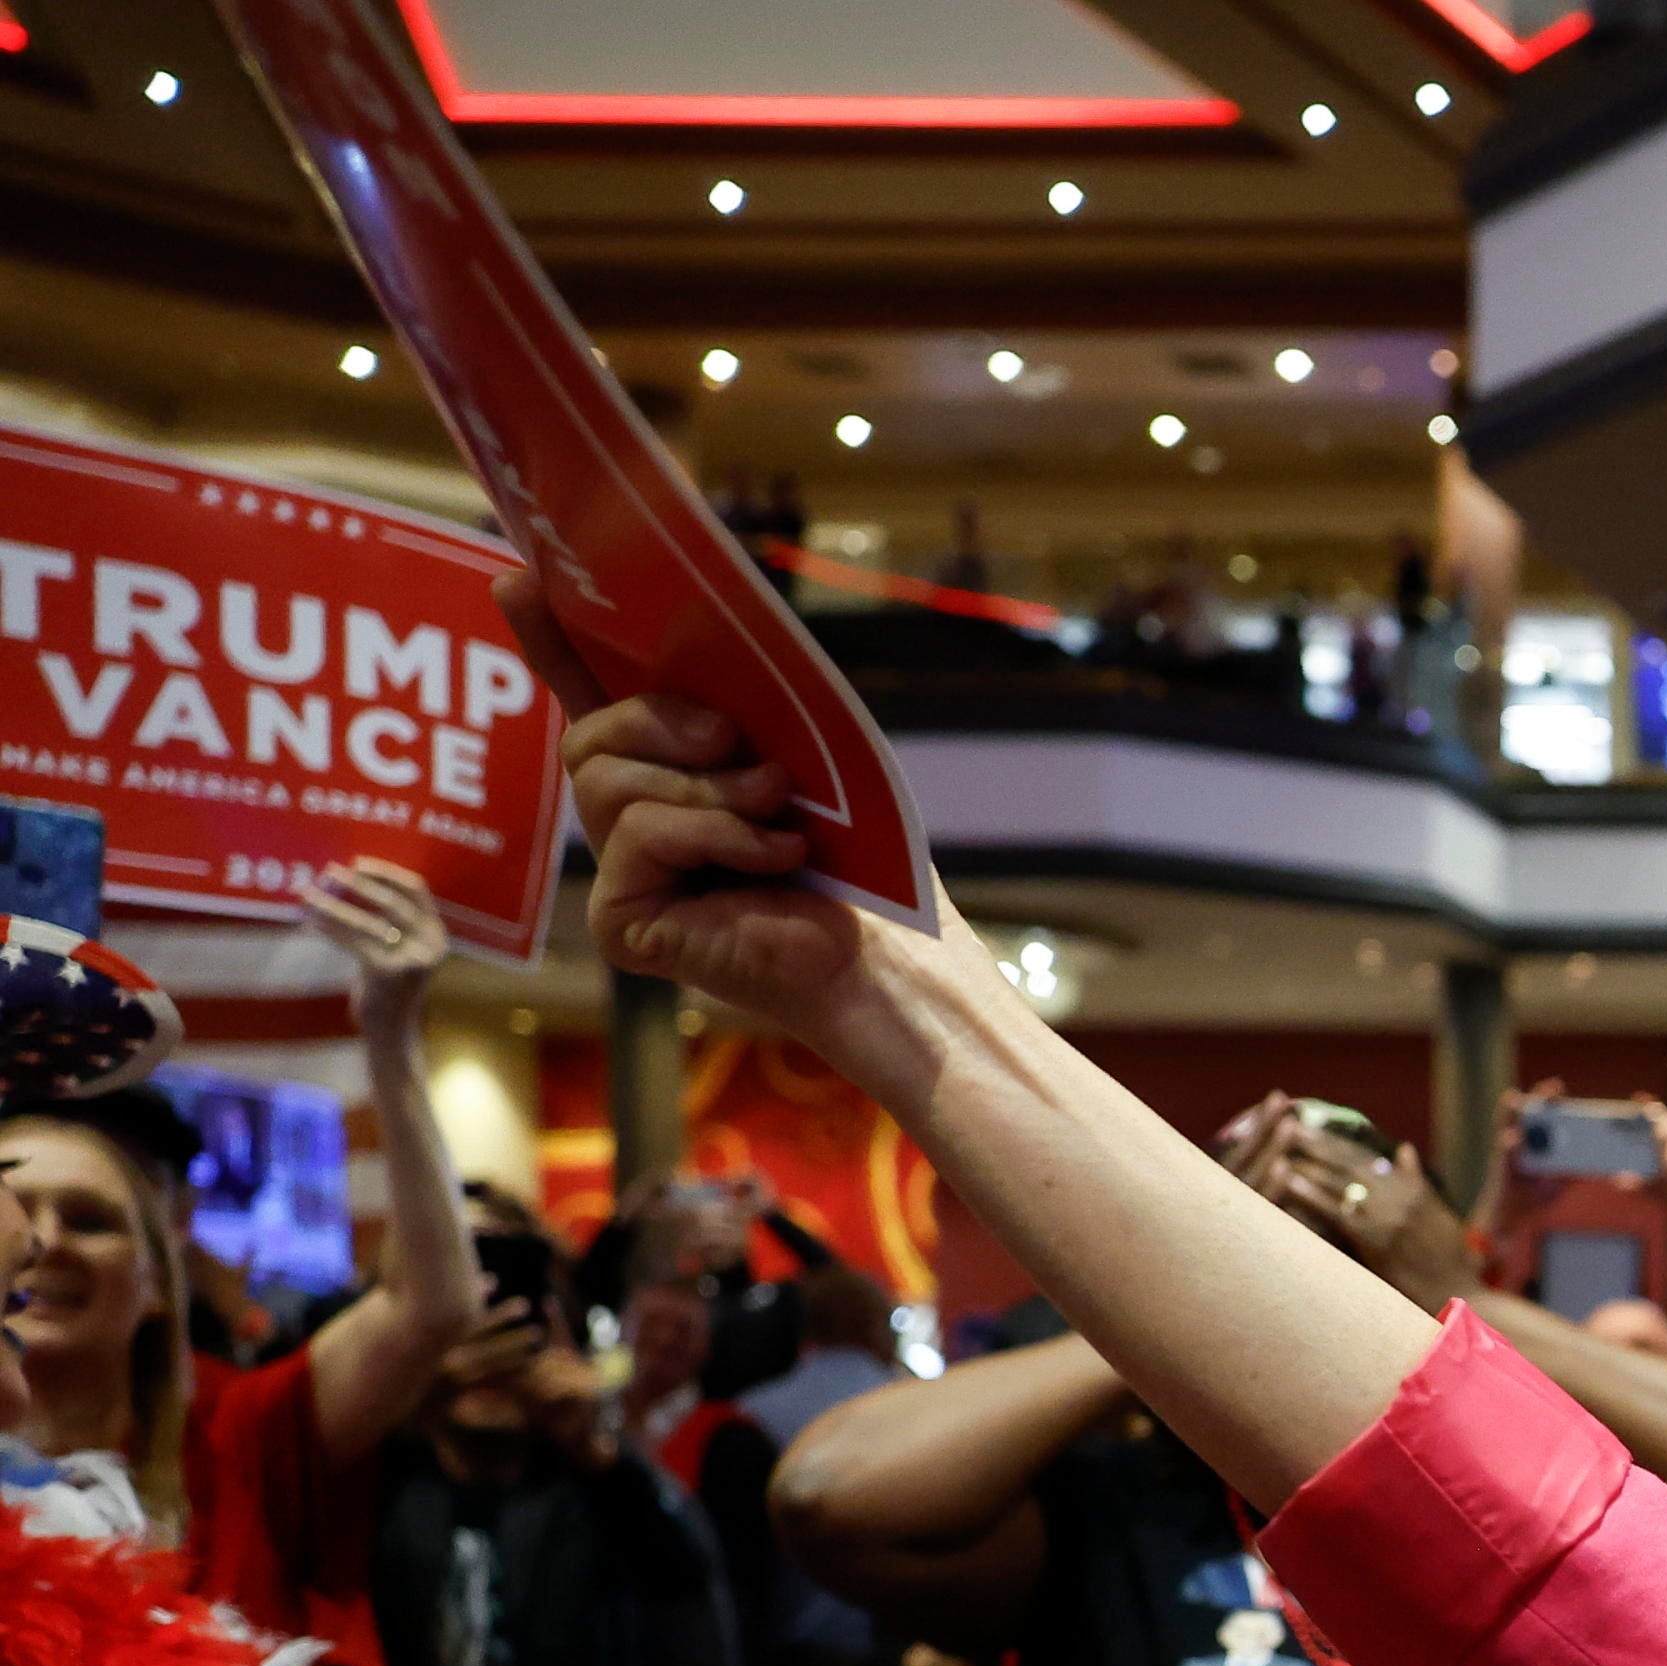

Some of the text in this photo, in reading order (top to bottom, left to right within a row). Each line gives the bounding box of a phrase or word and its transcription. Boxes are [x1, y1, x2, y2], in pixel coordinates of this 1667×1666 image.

[0, 538, 534, 732] TRUMP
[0, 741, 111, 786] MAKE
[121, 759, 292, 809] AMERICA
[36, 650, 488, 808] VANCE
[224, 850, 333, 893] 202
